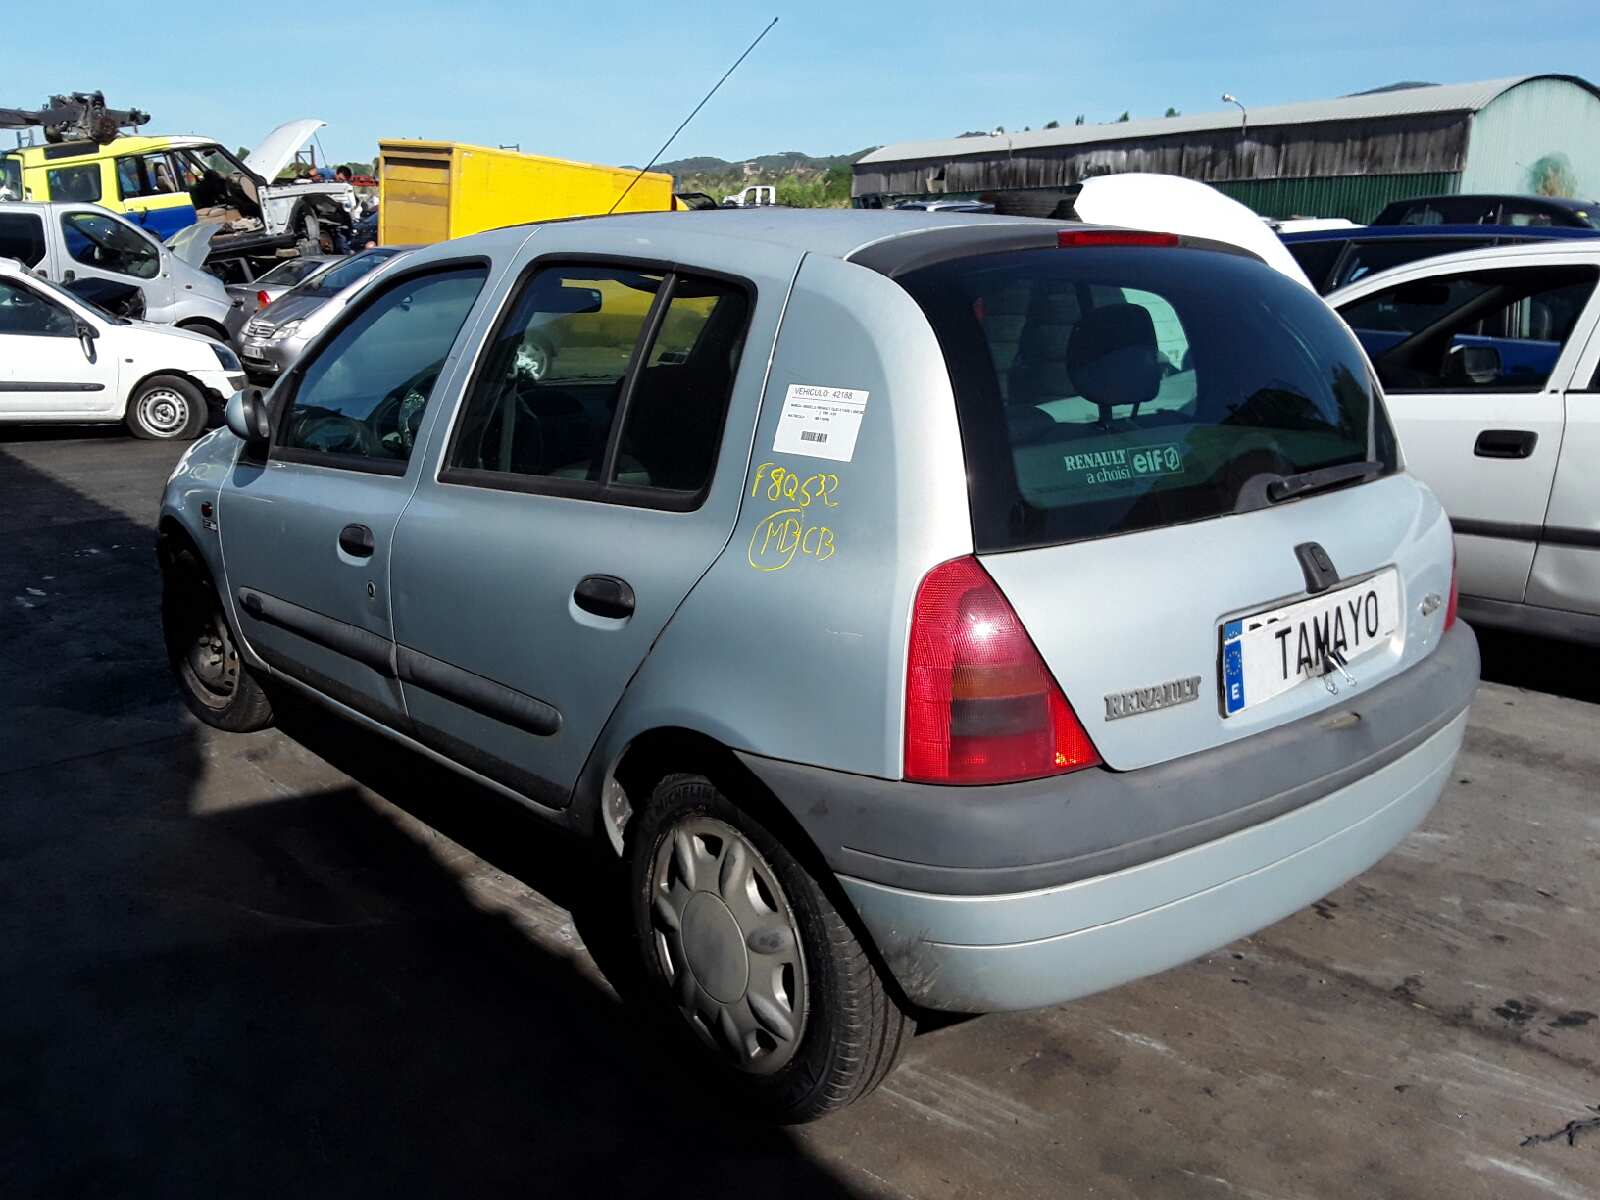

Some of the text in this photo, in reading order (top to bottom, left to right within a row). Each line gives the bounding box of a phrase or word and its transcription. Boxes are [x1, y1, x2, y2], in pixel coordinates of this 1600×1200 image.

[1064, 449, 1125, 471] RENAULT
[1086, 464, 1131, 484] a choisi
[1275, 590, 1379, 680] TAMAYO
[1103, 675, 1202, 722] RENAULT
[1230, 682, 1240, 699] E
